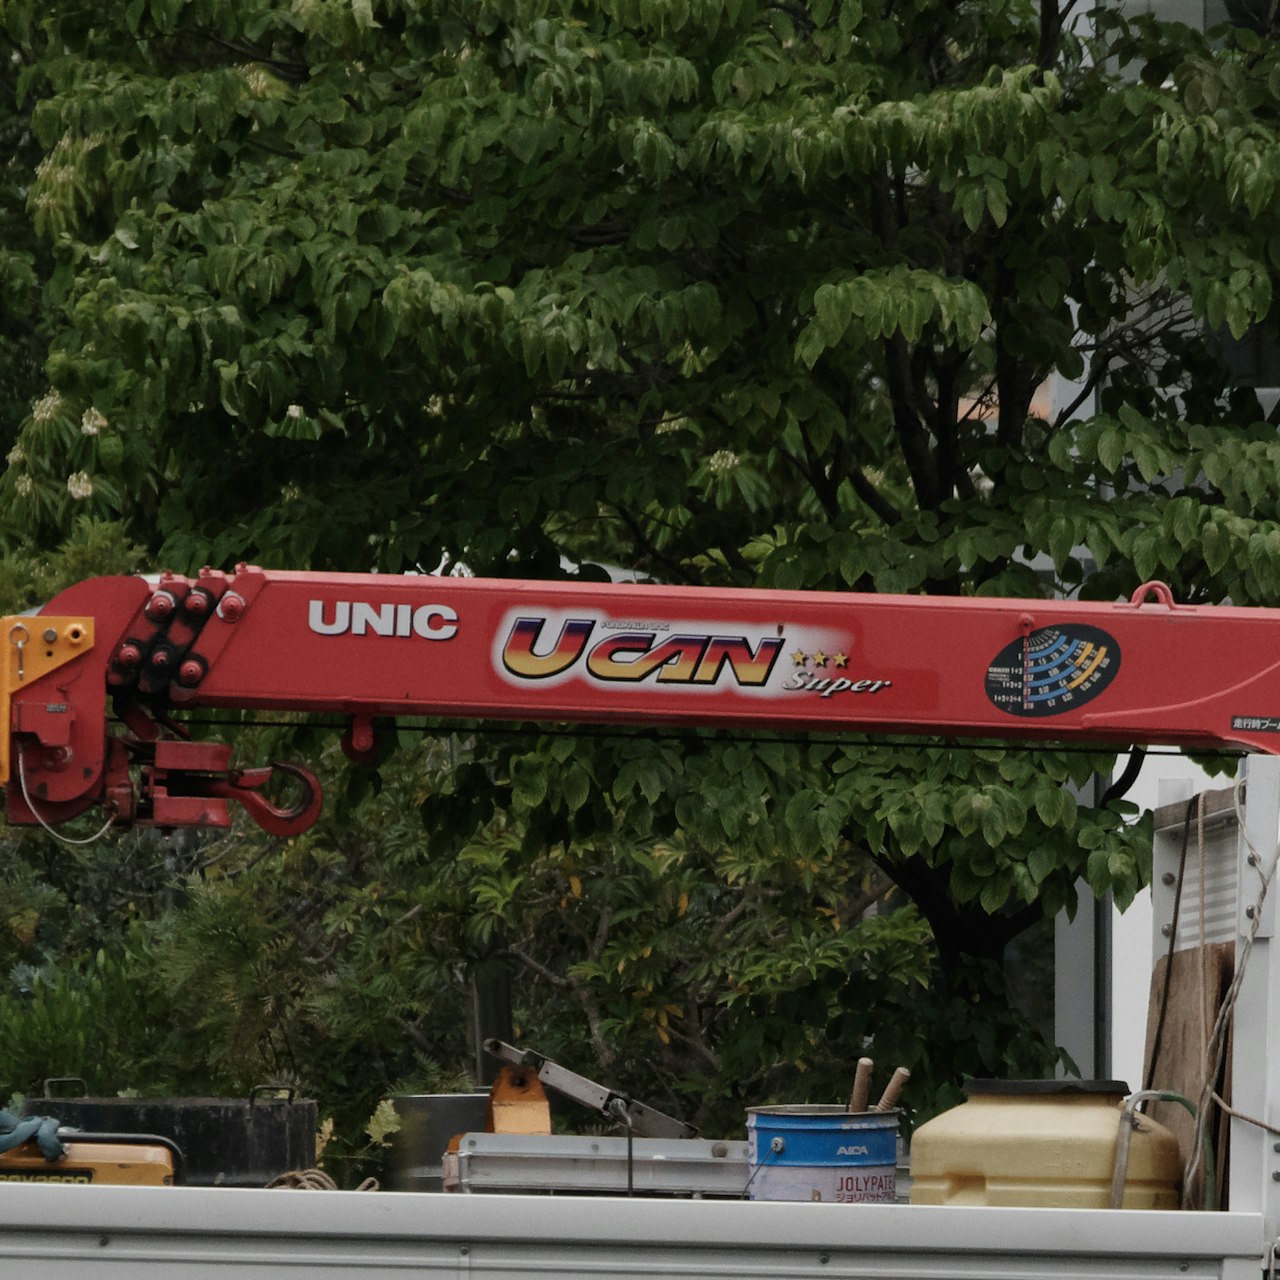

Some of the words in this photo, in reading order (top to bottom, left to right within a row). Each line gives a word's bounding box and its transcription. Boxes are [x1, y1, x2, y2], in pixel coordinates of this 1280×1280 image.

[309, 600, 459, 640] UNIC
[502, 617, 787, 687] UCAN
[782, 670, 893, 698] Super
